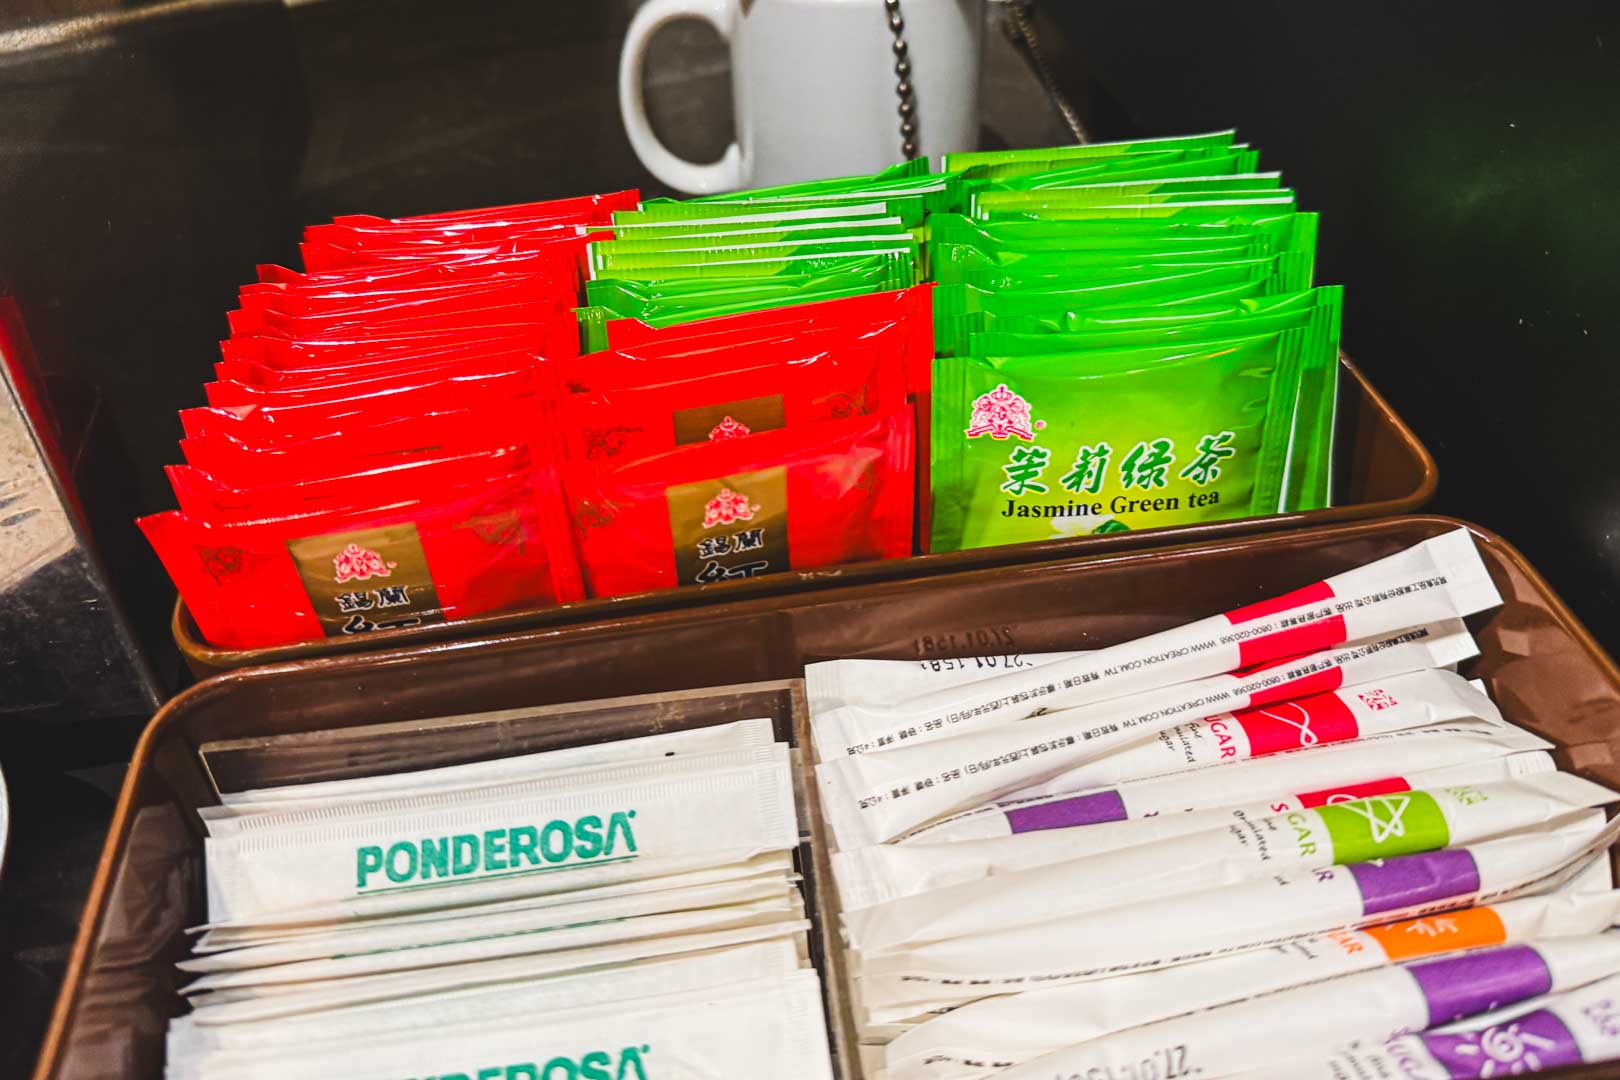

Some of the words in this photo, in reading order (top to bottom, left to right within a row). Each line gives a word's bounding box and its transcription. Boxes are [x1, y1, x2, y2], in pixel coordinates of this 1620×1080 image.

[1001, 499, 1102, 518] Jasmine
[1110, 494, 1180, 515] Green
[1187, 489, 1220, 508] tea
[1204, 714, 1236, 759] UGAR
[356, 809, 638, 889] PONDEROSA
[1287, 814, 1317, 856] GAR
